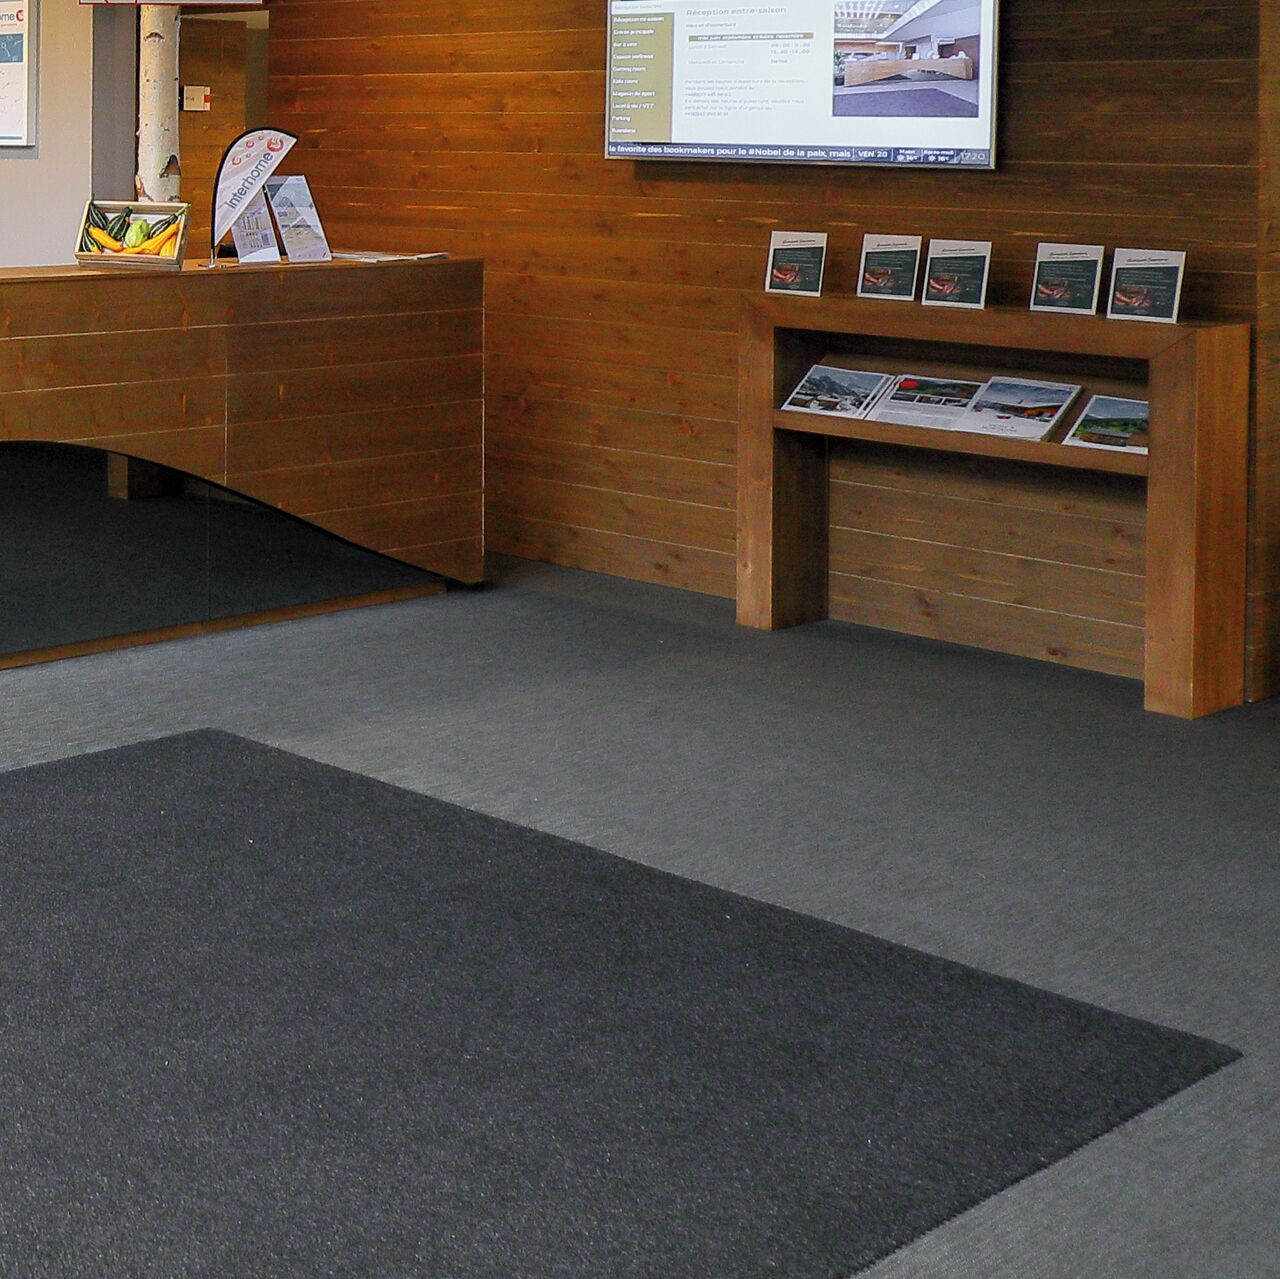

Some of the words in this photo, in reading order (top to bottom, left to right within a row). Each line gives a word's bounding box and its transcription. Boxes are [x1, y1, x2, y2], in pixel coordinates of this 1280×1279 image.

[686, 7, 730, 17] Réception
[617, 144, 647, 153] favorite
[647, 145, 662, 153] des
[664, 146, 715, 155] bookmakers
[716, 147, 738, 156] pour
[748, 147, 782, 156] #Nobel
[783, 148, 795, 157] de
[796, 148, 806, 157] la
[829, 150, 852, 158] mais
[225, 152, 274, 209] Interhome
